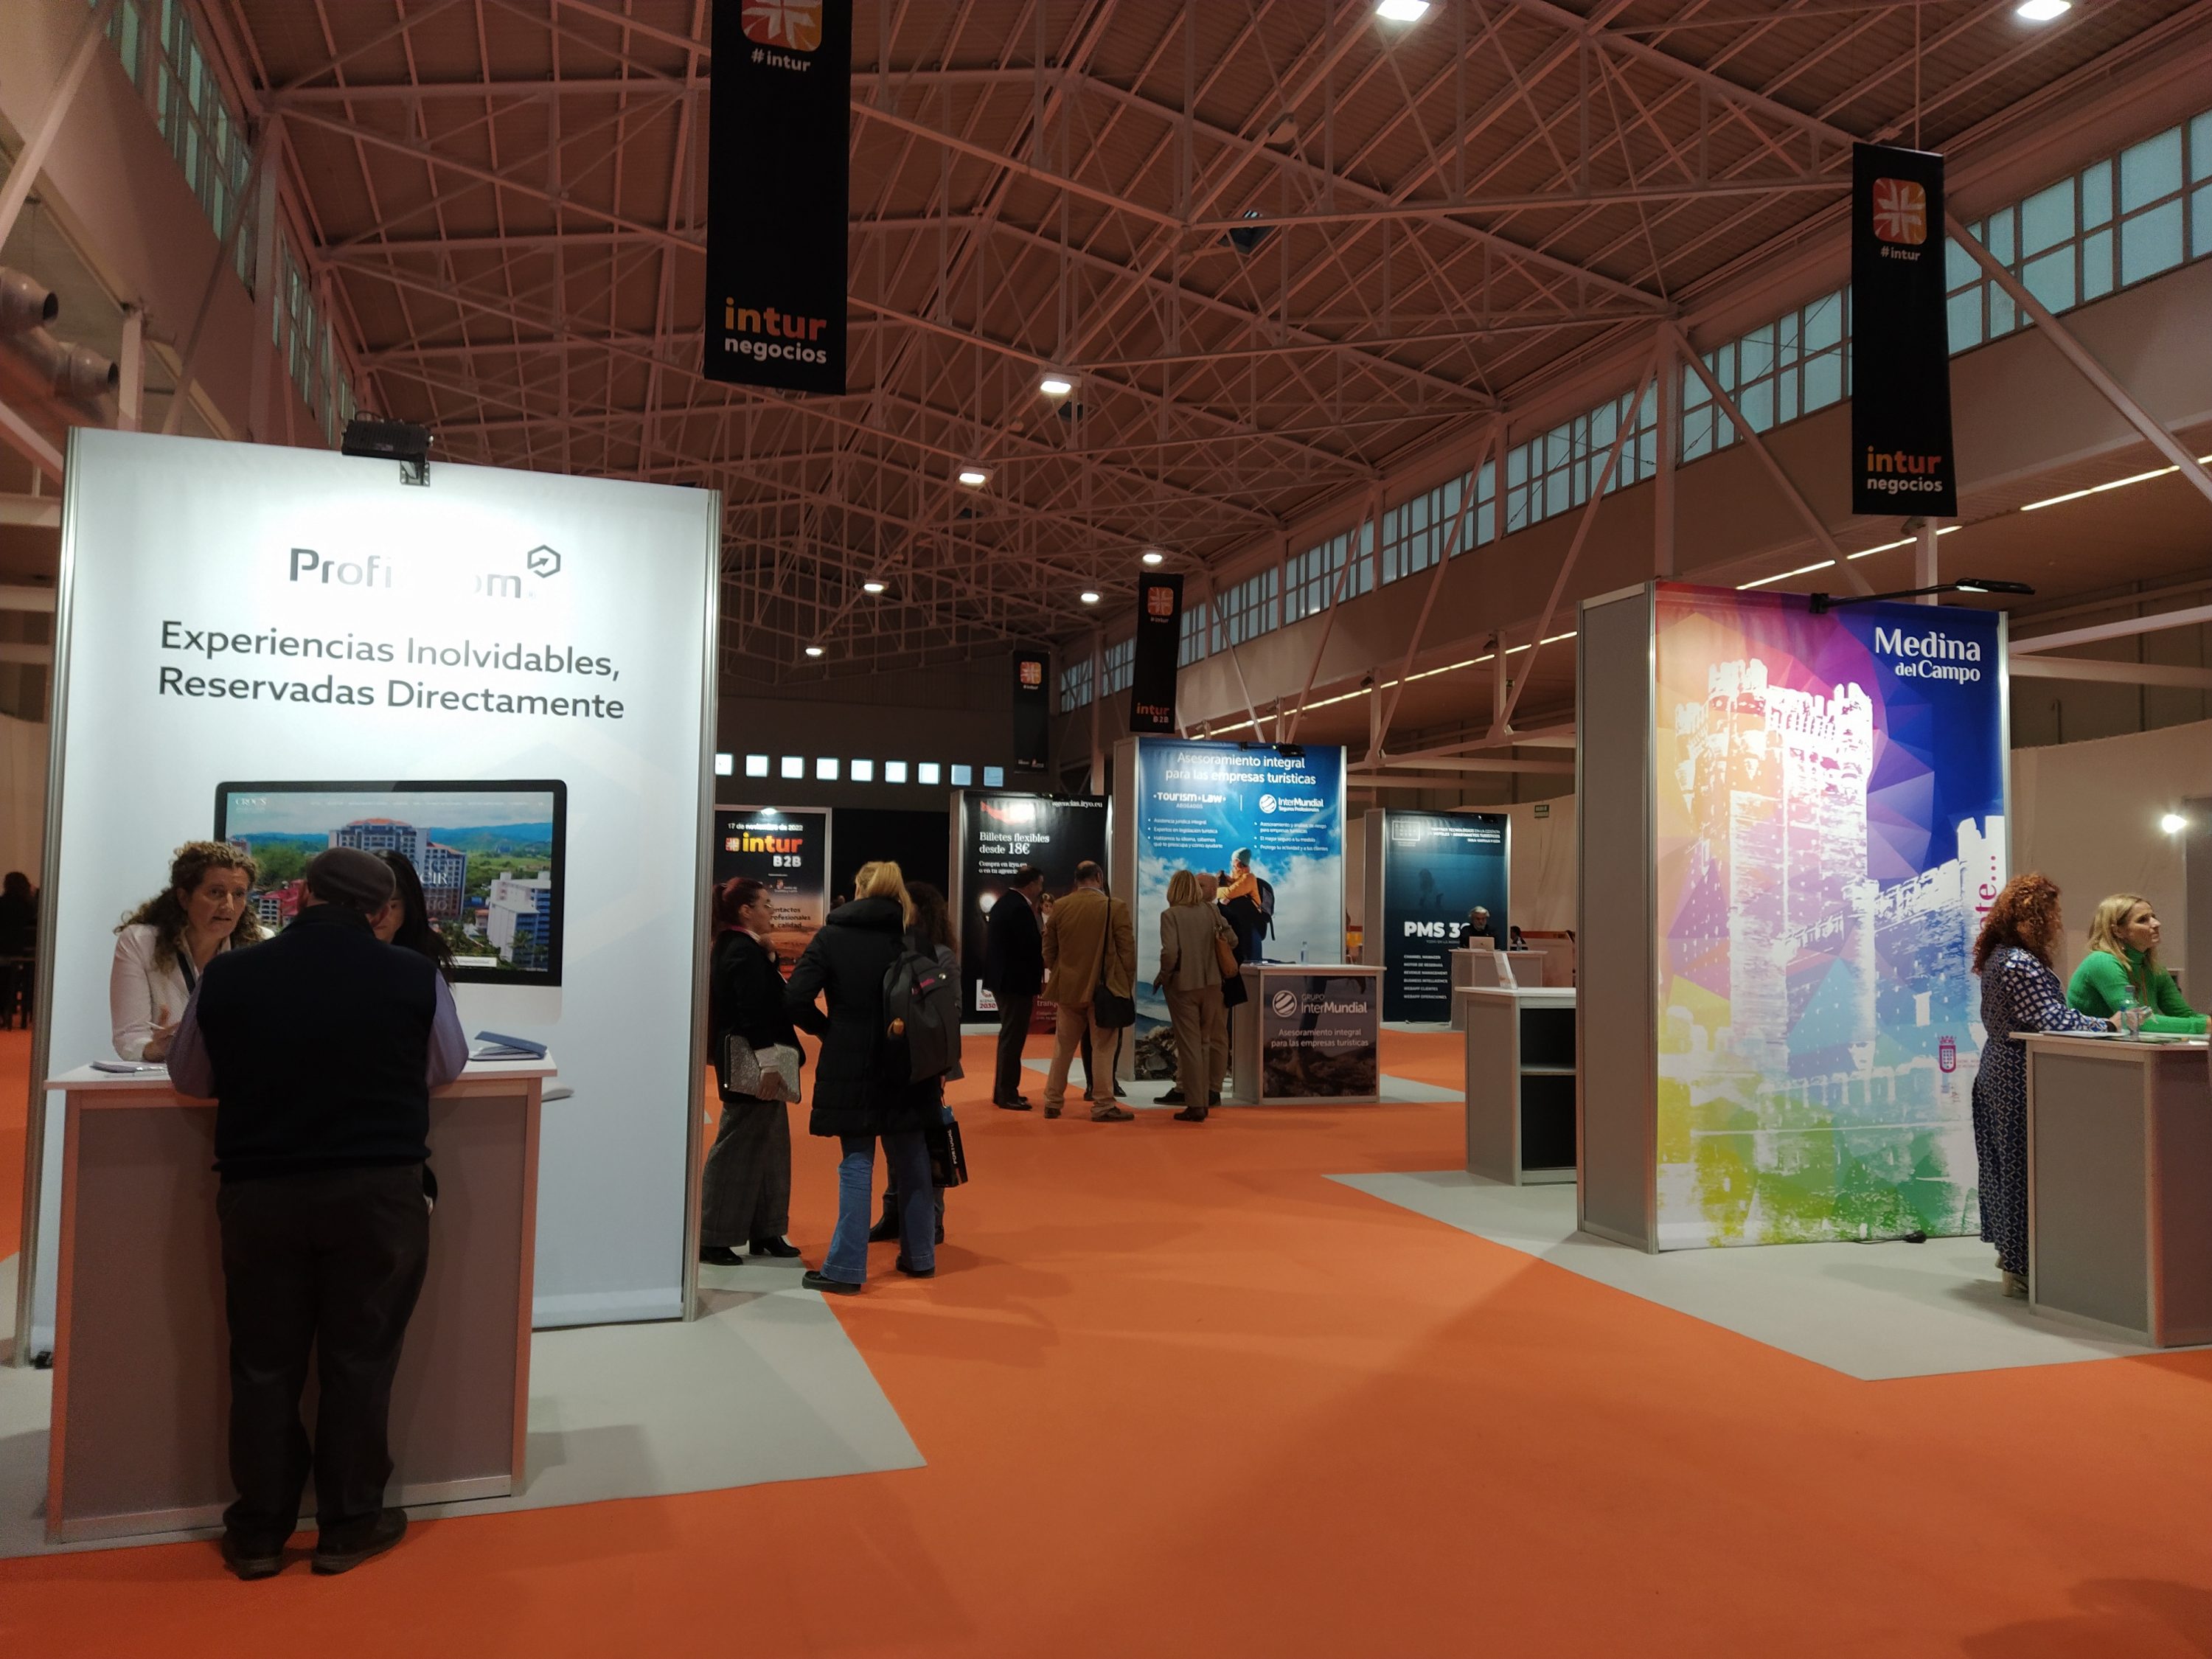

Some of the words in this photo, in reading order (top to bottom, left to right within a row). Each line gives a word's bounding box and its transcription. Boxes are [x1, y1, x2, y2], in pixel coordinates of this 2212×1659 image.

[751, 48, 811, 72] #intur
[1880, 246, 1921, 260] #intur
[725, 296, 827, 341] intur
[725, 338, 827, 364] negocios
[1867, 445, 1941, 473] intur
[1867, 476, 1943, 495] negocios
[161, 620, 394, 662] Experiencias
[408, 637, 619, 681] Inolvidables,
[1875, 627, 1981, 661] Medina
[1918, 660, 1980, 684] Campo
[159, 666, 375, 706] Reservadas
[387, 679, 624, 719] Directamente
[1136, 703, 1169, 715] intur
[1177, 752, 1261, 767] Asesoramiento
[1263, 756, 1305, 771] integral
[1166, 770, 1190, 781] para
[1194, 770, 1208, 780] las
[1211, 772, 1265, 783] empresas
[1278, 797, 1324, 807] InterMundial
[742, 831, 803, 853] intur
[979, 832, 1012, 841] Billetes
[1014, 832, 1050, 843] flexibles
[979, 844, 1006, 854] desde
[1008, 842, 1030, 855] 18€
[773, 855, 801, 867] B2B
[1404, 921, 1445, 938] PMS
[1301, 1001, 1368, 1013] InterMundial
[1334, 1029, 1361, 1037] integral
